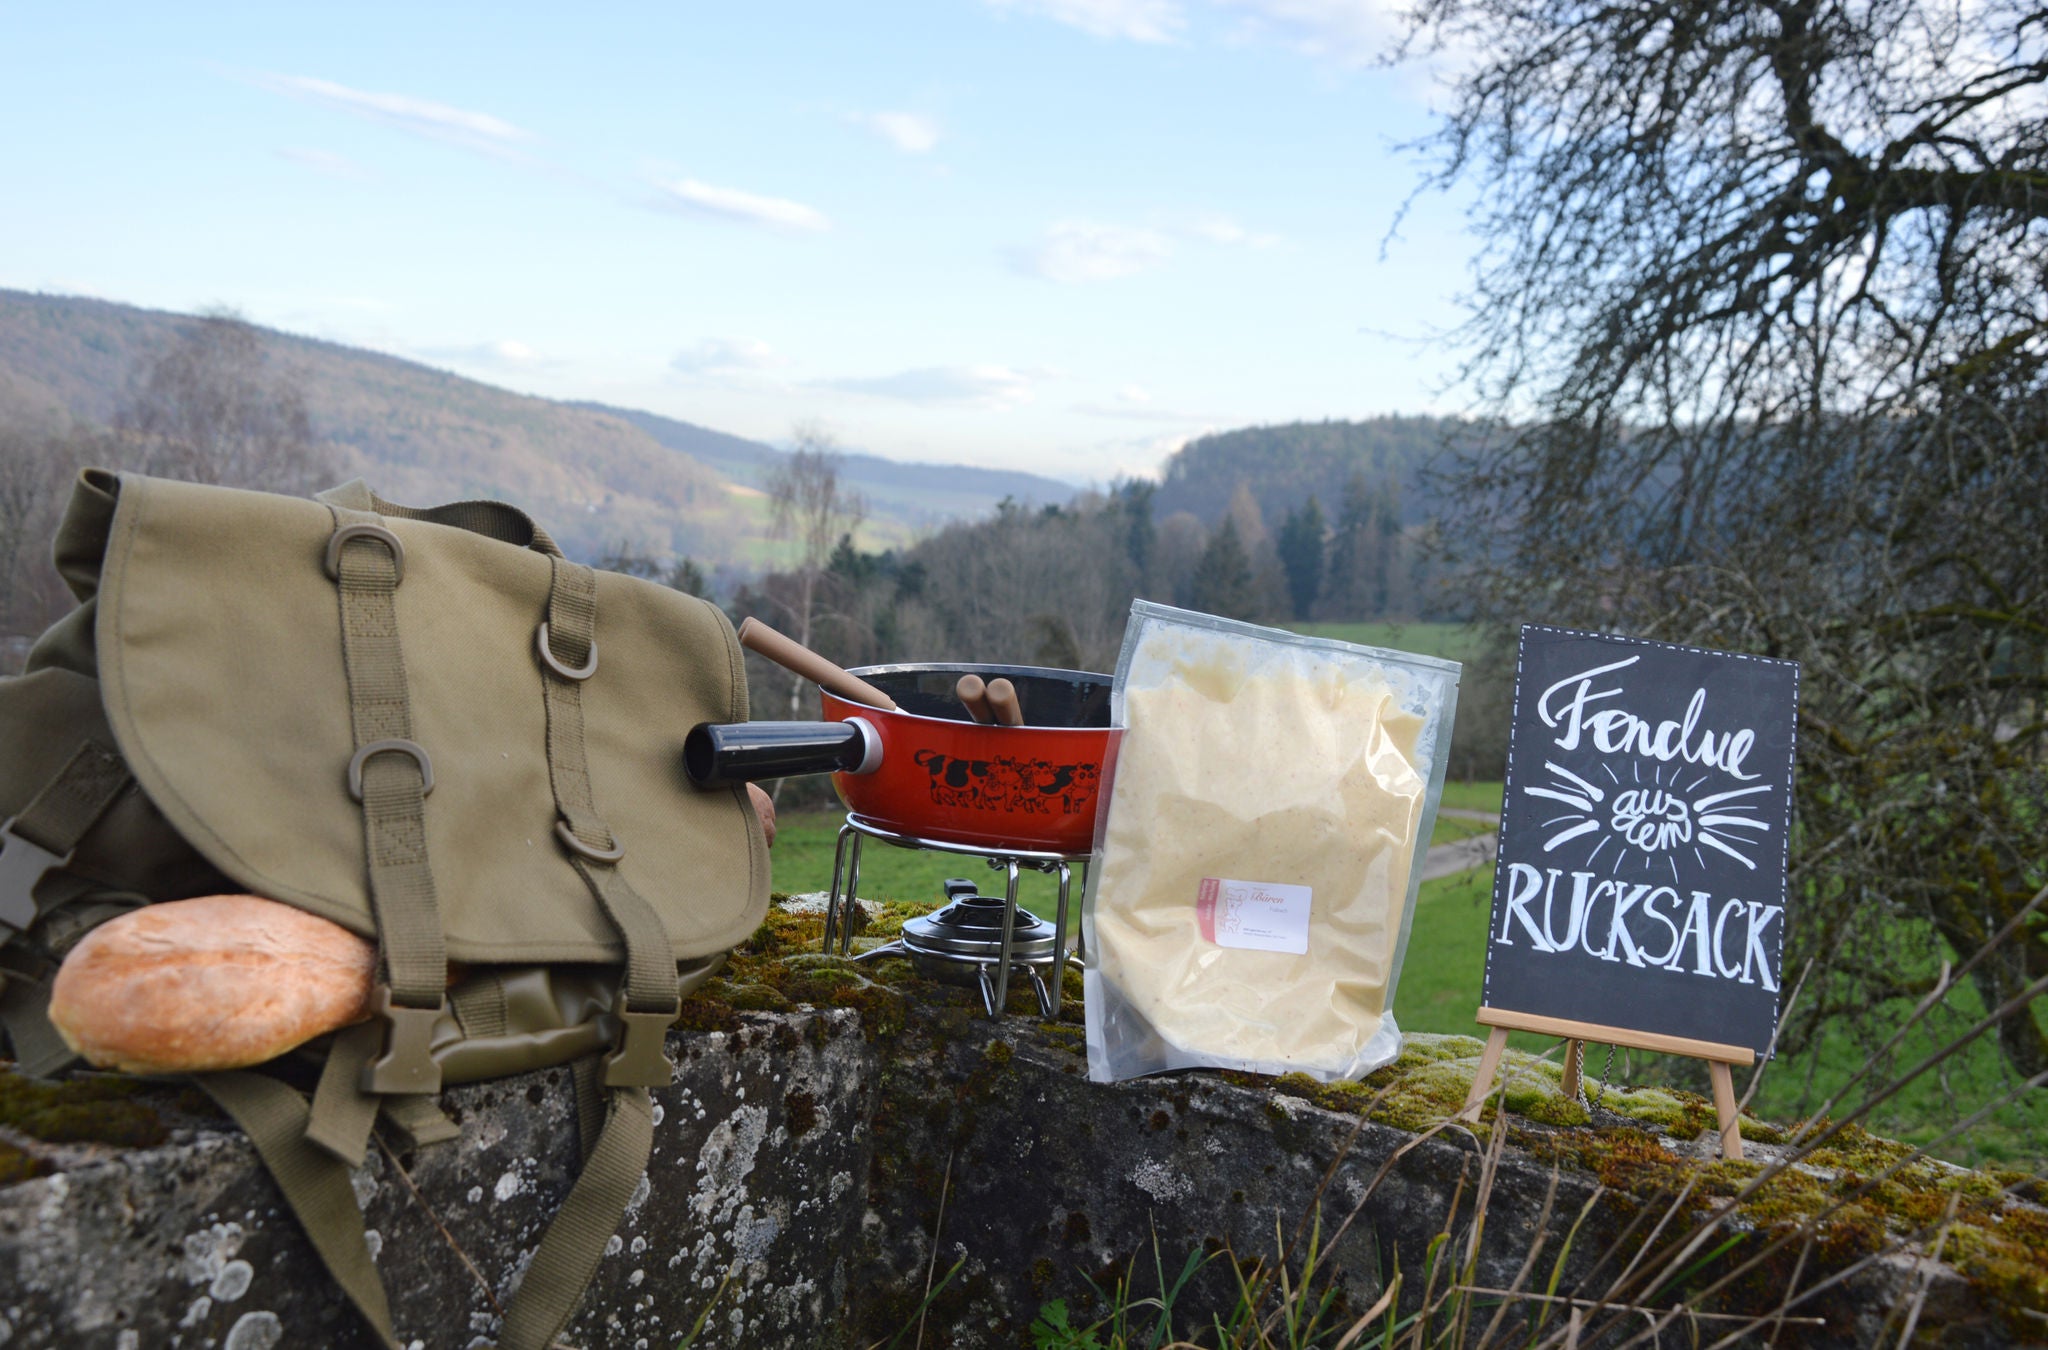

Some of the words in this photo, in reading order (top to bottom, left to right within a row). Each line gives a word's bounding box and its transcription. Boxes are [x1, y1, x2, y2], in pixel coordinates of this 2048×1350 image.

[1537, 655, 1762, 780] Fondue
[1612, 788, 1688, 826] aus
[1496, 862, 1784, 992] RUCKSACK
